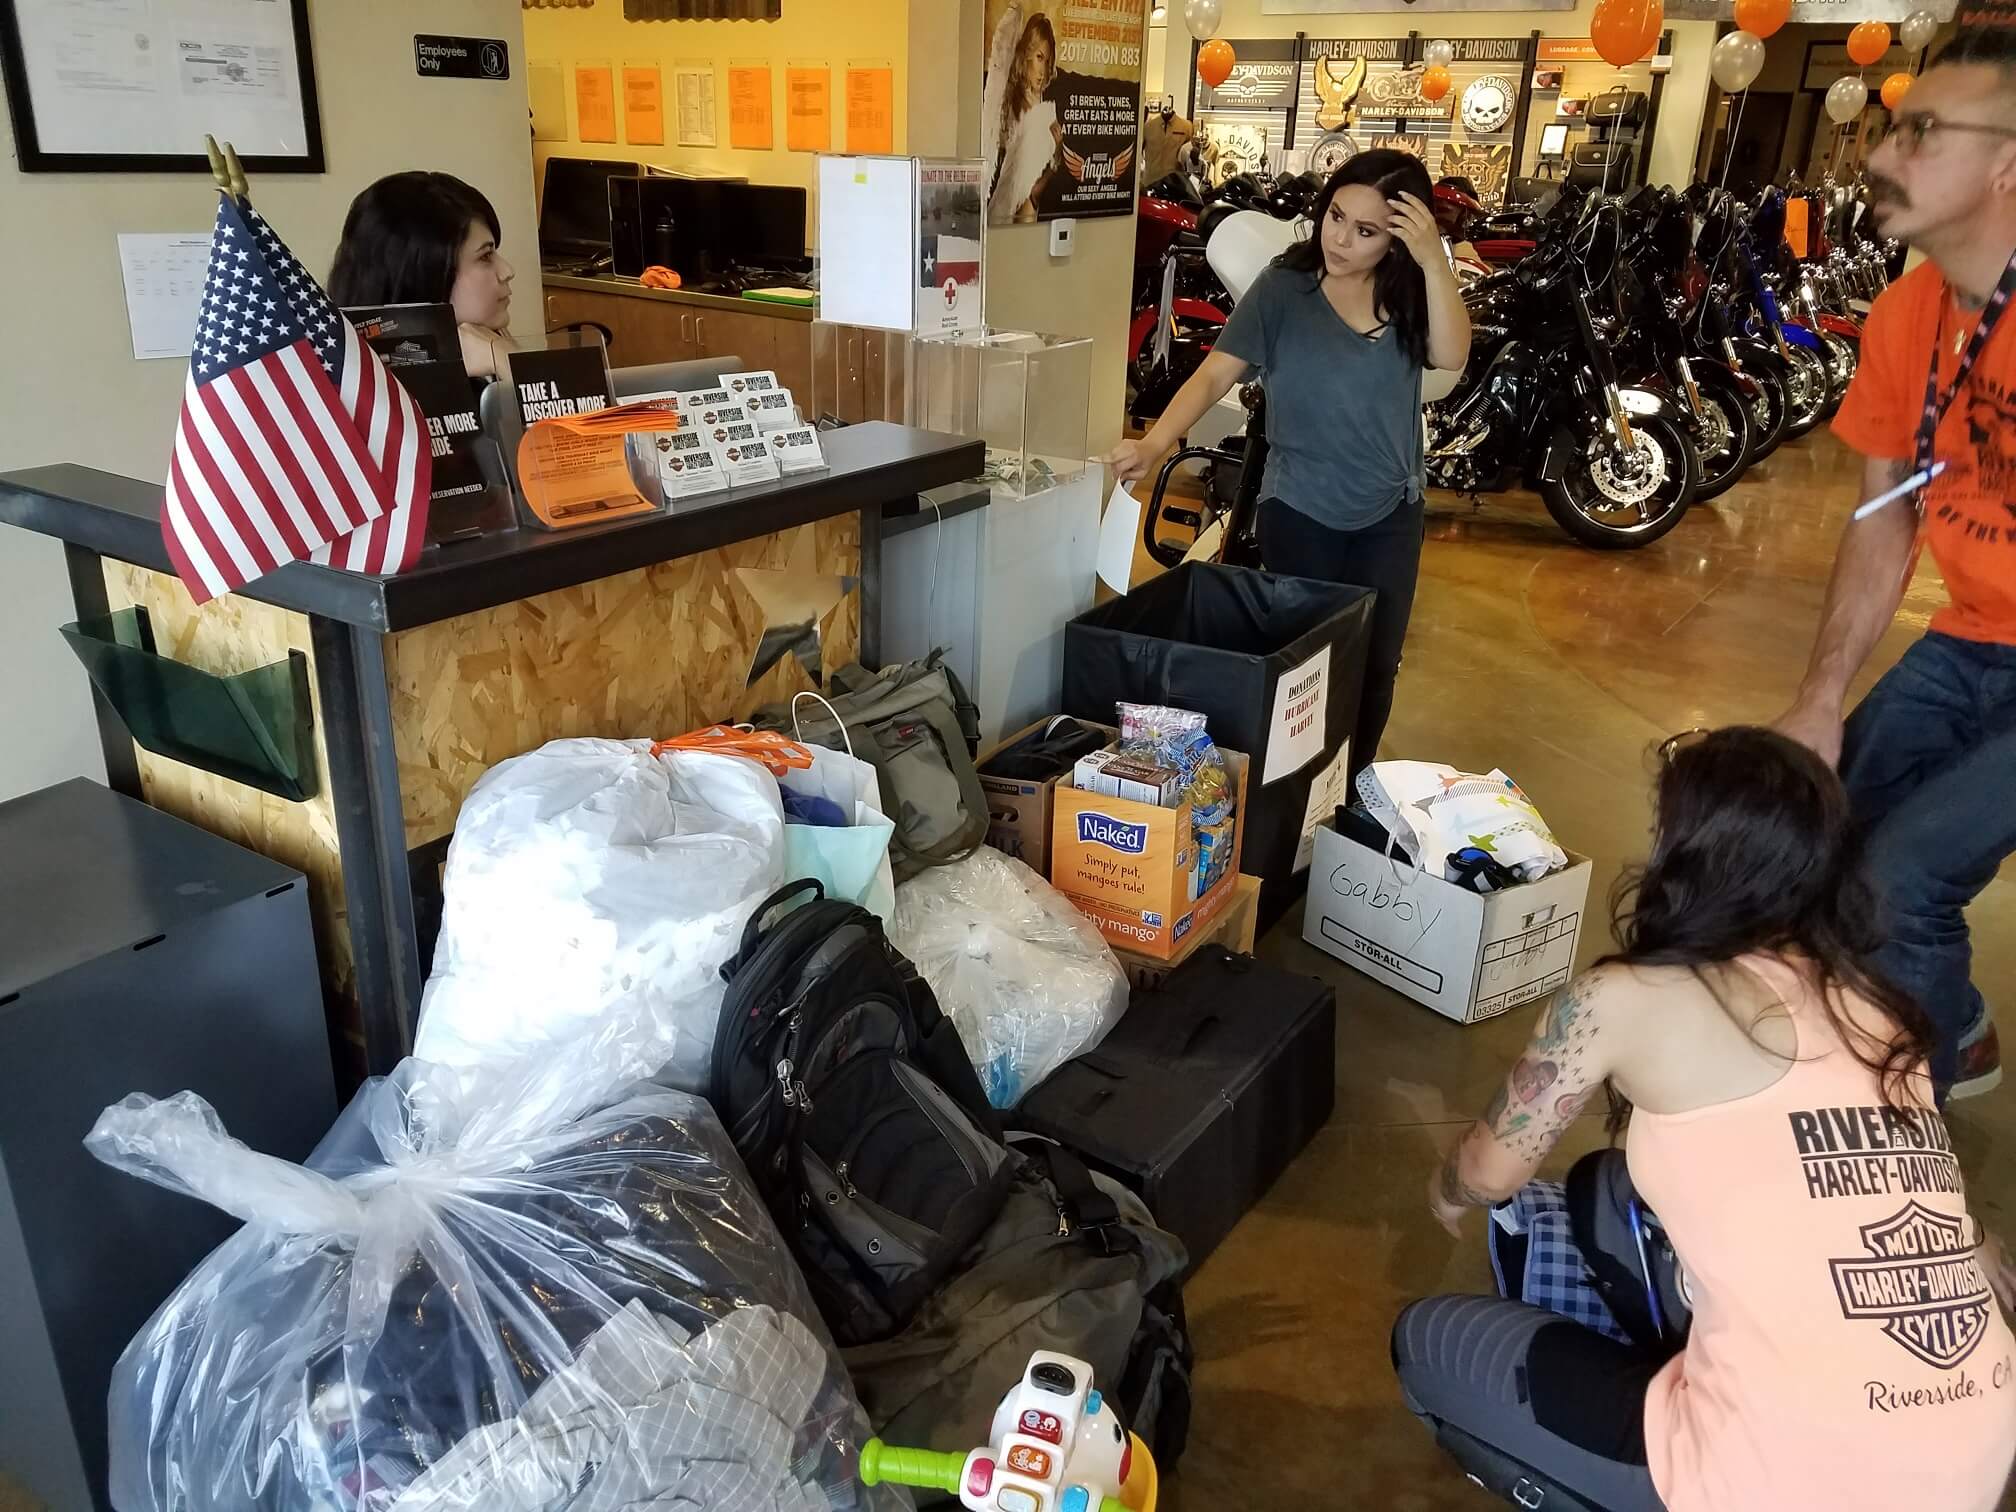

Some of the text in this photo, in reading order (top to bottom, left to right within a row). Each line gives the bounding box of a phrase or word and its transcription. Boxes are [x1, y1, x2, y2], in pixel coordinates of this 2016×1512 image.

[419, 43, 467, 58] Employees
[1060, 41, 1140, 66] 2017 IRON 883
[1309, 40, 1398, 59] HARLEY-DAVIDSON
[420, 57, 440, 71] Only
[1231, 64, 1294, 75] EY-DAVIDSON
[1070, 94, 1131, 109] $1 BREWS, TUNES,
[1361, 107, 1445, 116] HARLEY-DAVIDSON
[1064, 109, 1135, 121] GREAT EATS & MORE
[1061, 123, 1136, 135] AT EVERY BIKE NIGHT!
[1082, 156, 1115, 184] Angels
[1077, 185, 1087, 193] OUR
[519, 380, 559, 402] TAKE A
[703, 392, 729, 401] RIVERSIDE
[760, 393, 785, 403] RIVERSIDE
[522, 394, 606, 422] DISCOVER MORE
[717, 407, 743, 417] RIVERSIDE
[444, 412, 479, 434] MORE
[728, 424, 753, 434] RIVERSIDE
[671, 432, 698, 442] RIVERSIDE
[786, 430, 812, 441] RIVERSIDE
[432, 437, 454, 457] IDE
[684, 452, 711, 462] RIVERSIDE
[740, 442, 767, 452] RIVERSIDE
[432, 483, 483, 499] RESERVATION NEEDED
[1964, 519, 1999, 544] THE
[1288, 668, 1320, 699] DONATIONS
[1284, 688, 1319, 720] HURRICANE
[1290, 713, 1313, 737] HARVEY
[1084, 818, 1138, 848] Naked
[1084, 853, 1140, 879] Simply put,
[1077, 869, 1145, 895] mangoes rule!
[1330, 864, 1441, 955] Gabby
[1084, 908, 1156, 941] hty mango
[1354, 938, 1402, 971] STOR-ALL
[1508, 986, 1537, 1003] STOR-ALL
[1476, 1001, 1502, 1017] 03325
[1803, 1155, 1961, 1199] HARLEY-DAVIDSO
[1884, 1218, 1956, 1257] MOTOR
[1848, 1258, 1988, 1306] HARLEY-DAVIDSO
[1904, 1307, 1980, 1357] CYCLES
[1864, 1370, 1984, 1413] Riverside,
